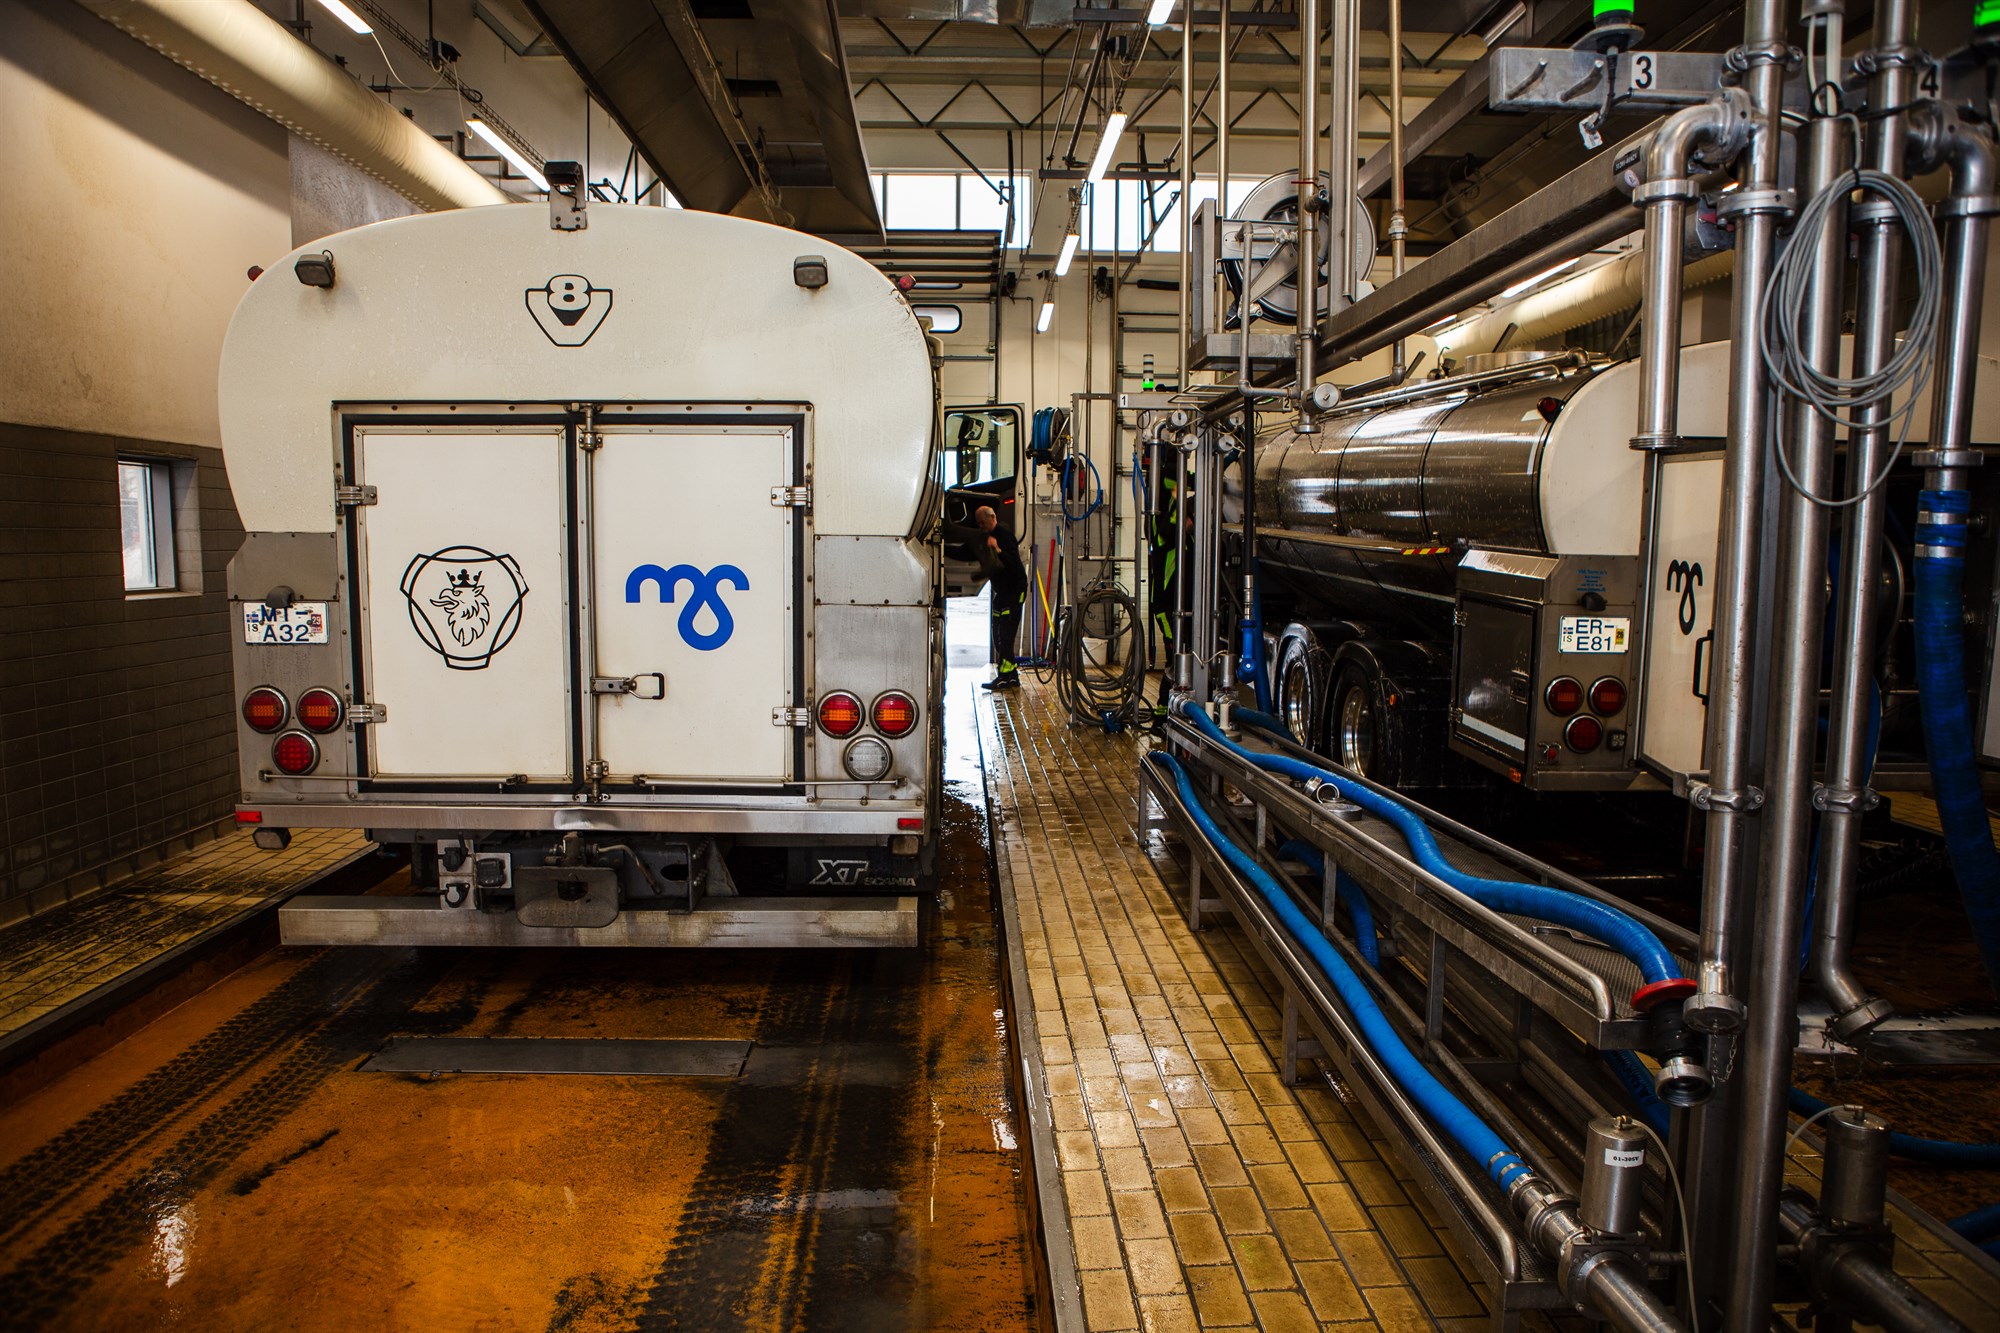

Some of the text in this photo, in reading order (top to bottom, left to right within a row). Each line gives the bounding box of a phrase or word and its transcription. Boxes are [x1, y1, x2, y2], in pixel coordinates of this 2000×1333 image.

[1635, 55, 1652, 89] 3
[1920, 64, 1939, 98] 4
[1121, 395, 1126, 406] 1
[1284, 397, 1290, 408] 2
[263, 624, 310, 642] A32
[1576, 619, 1615, 634] ER-
[1576, 636, 1611, 651] E81
[809, 859, 917, 887] XT SCANIA
